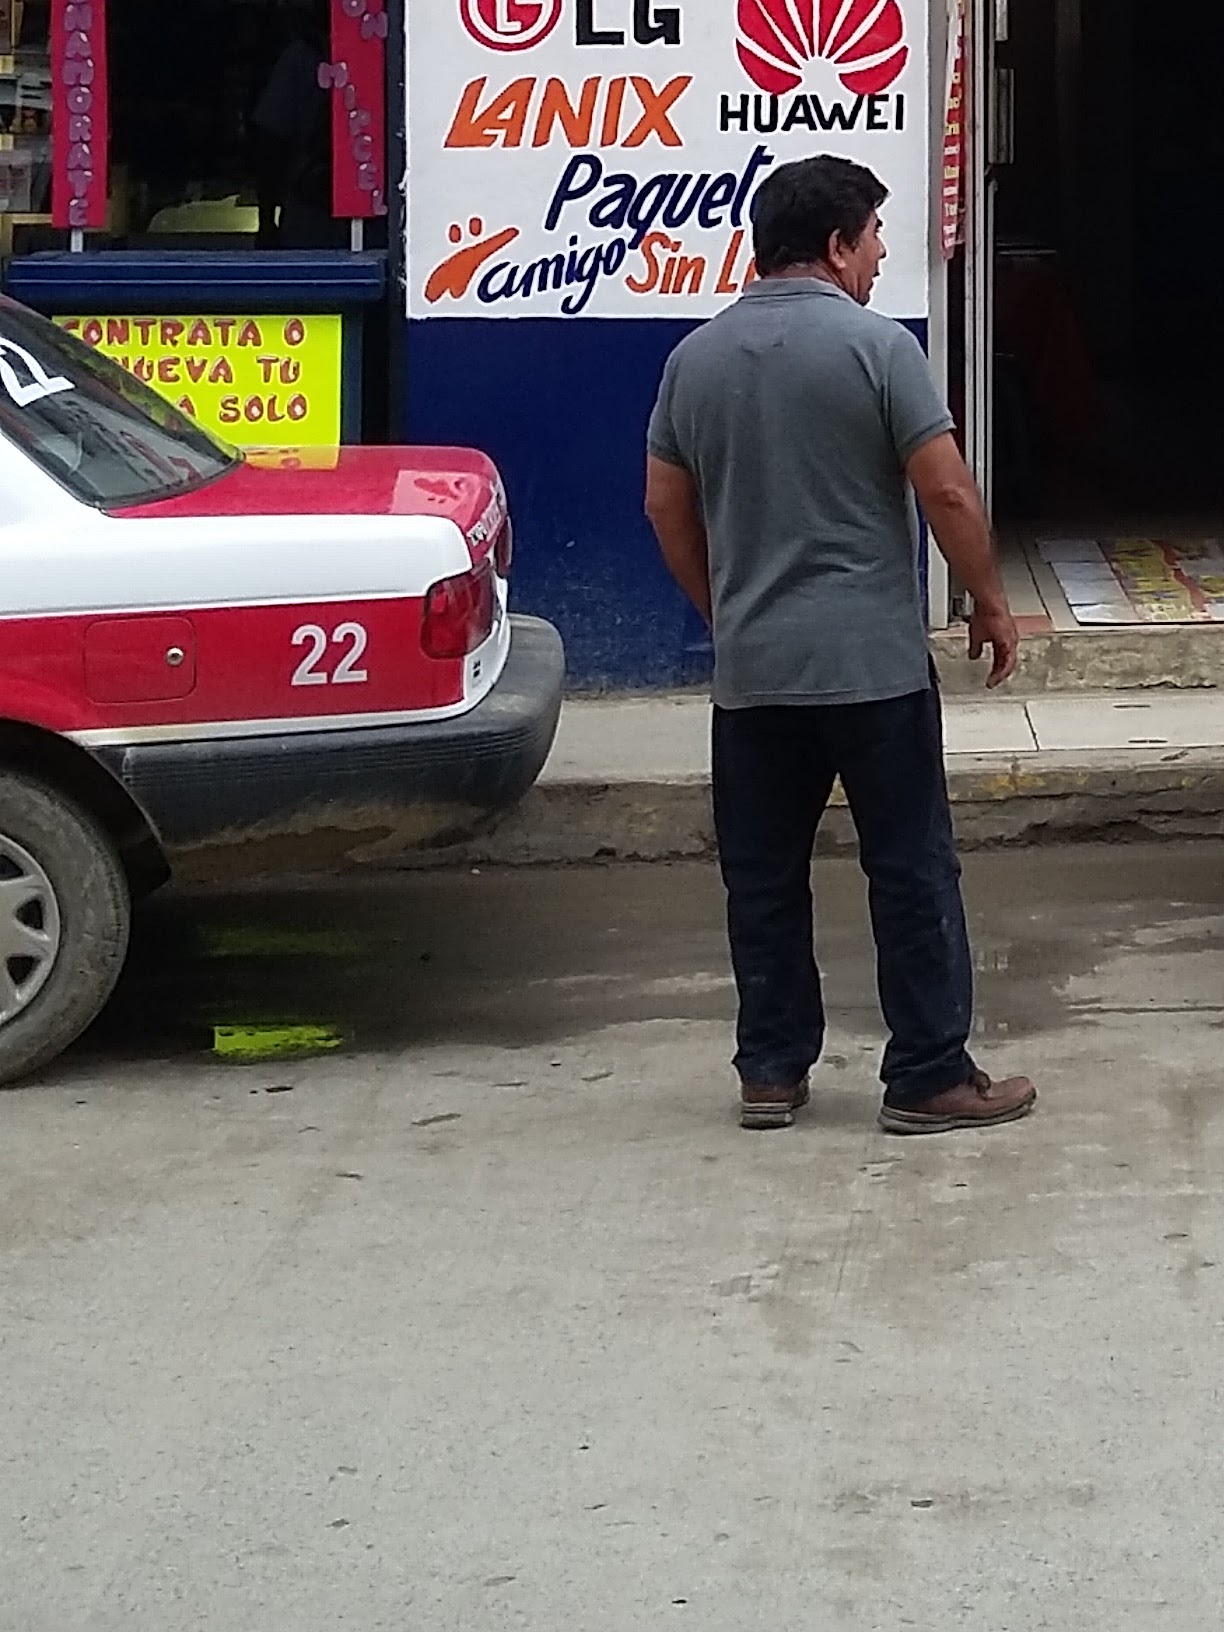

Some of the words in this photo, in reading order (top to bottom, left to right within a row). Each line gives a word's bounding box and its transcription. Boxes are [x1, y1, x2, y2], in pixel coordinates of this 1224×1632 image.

[444, 75, 694, 148] LANIX
[719, 93, 905, 132] HUAWEI
[545, 145, 773, 249] Paquet
[478, 233, 628, 314] amigo
[625, 231, 706, 294] Sin
[284, 318, 305, 345] O
[256, 356, 300, 383] TU
[218, 394, 307, 423] SOLO
[290, 621, 368, 686] 22
